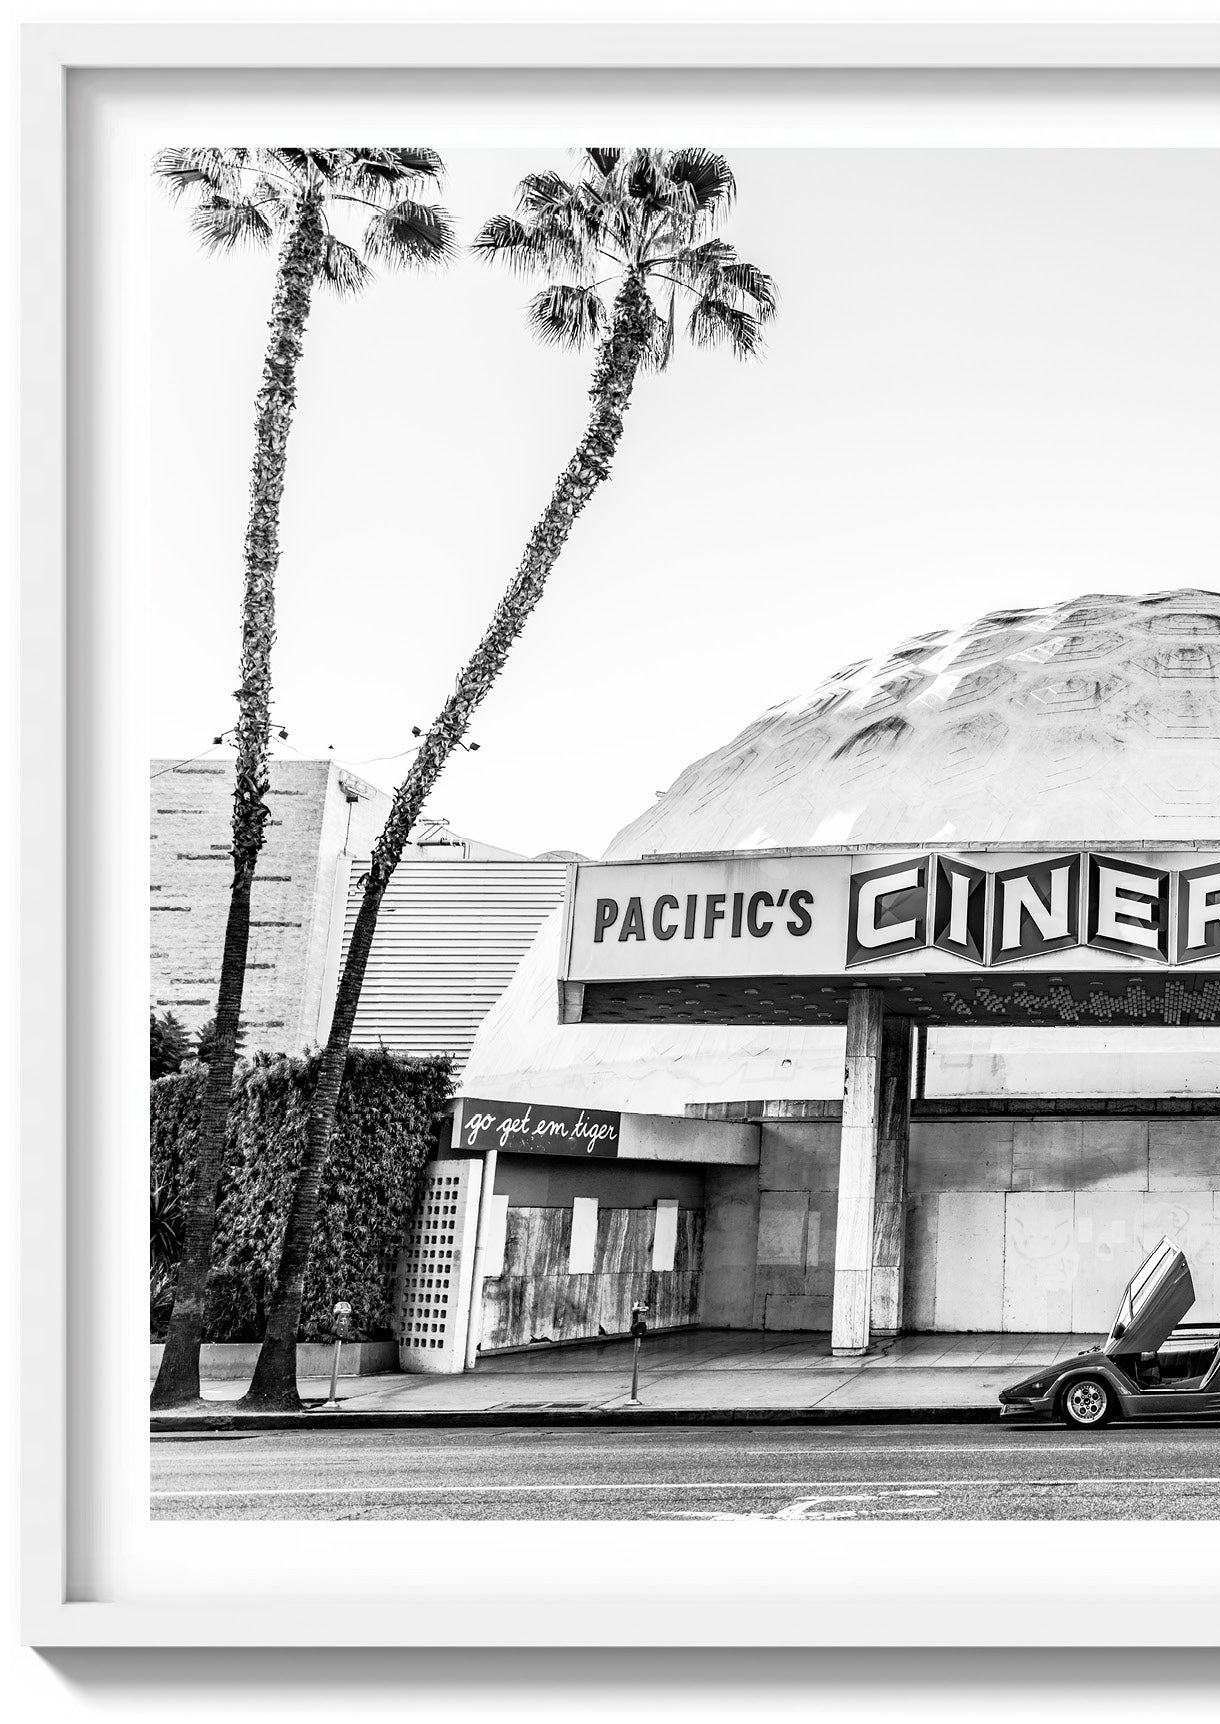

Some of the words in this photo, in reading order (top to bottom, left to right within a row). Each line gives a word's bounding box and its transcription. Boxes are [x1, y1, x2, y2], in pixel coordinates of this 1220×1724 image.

[593, 889, 815, 943] PACIFIC'S
[465, 1113, 496, 1145] go
[496, 1105, 531, 1147] get
[532, 1119, 568, 1137] em
[570, 1110, 617, 1153] tiger
